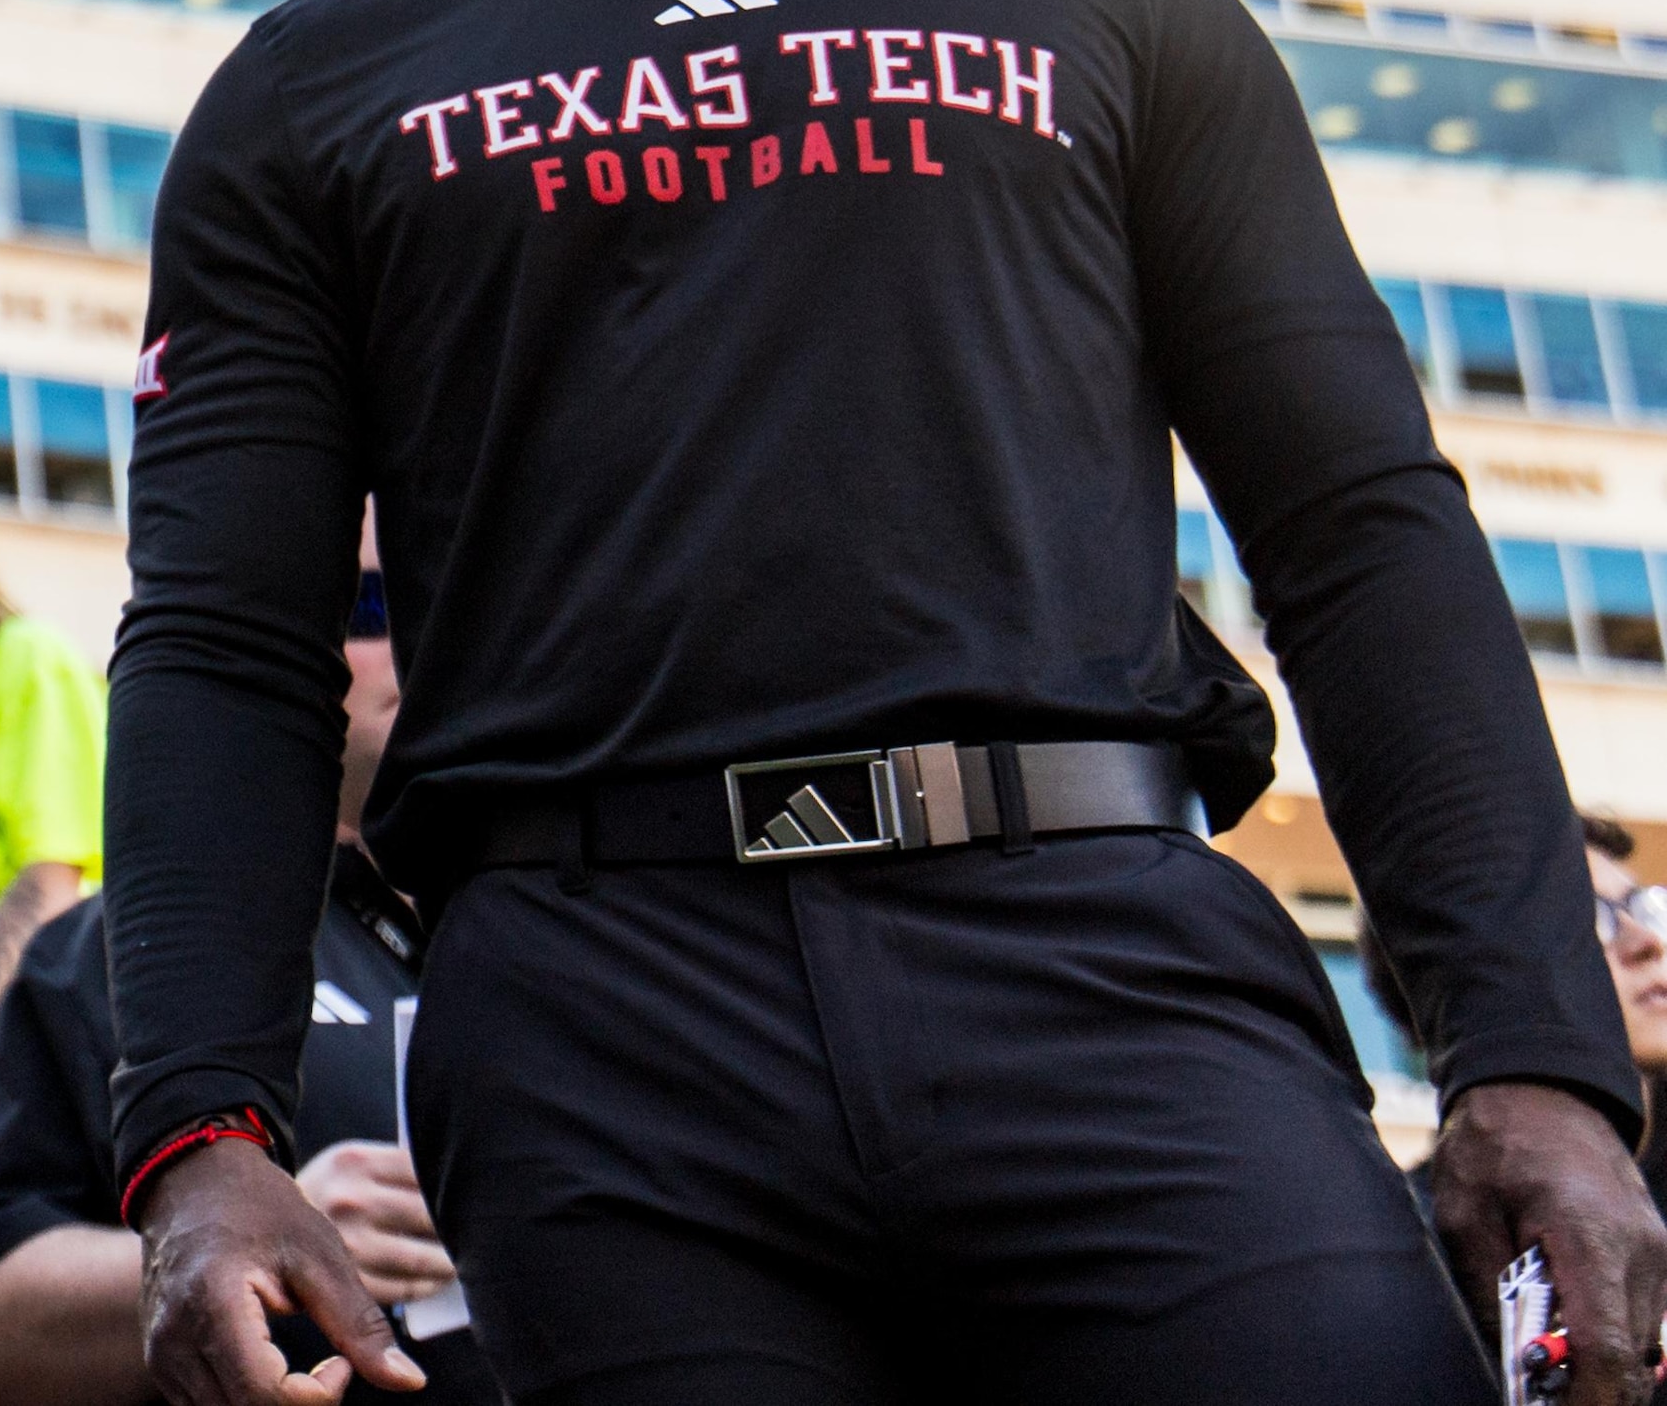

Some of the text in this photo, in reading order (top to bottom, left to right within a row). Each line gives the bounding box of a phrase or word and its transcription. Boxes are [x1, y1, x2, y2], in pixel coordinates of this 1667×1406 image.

[398, 44, 751, 182] TEXAS
[779, 28, 1056, 139] TECH
[531, 117, 945, 213] FOOTBALL
